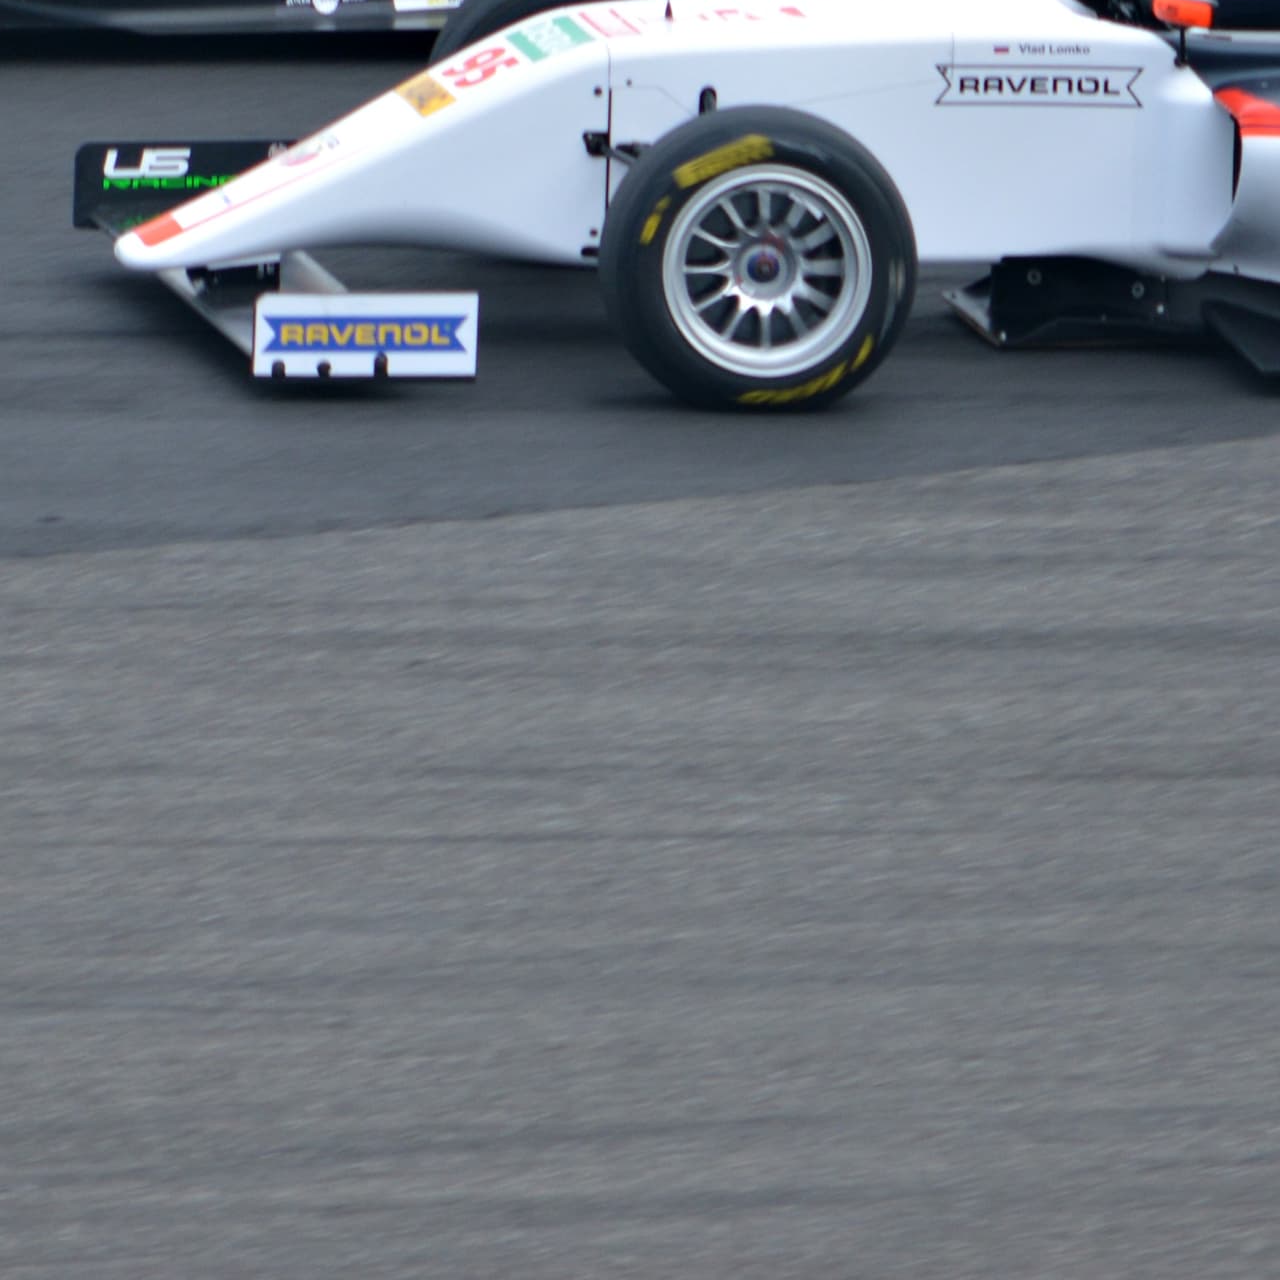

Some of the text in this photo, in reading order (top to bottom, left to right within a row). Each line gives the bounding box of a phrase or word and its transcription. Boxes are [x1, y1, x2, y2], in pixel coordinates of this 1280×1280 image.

[1019, 44, 1090, 55] Vlad Lomko
[959, 76, 1120, 95] RAVENOL
[280, 323, 451, 346] RAVENOL
